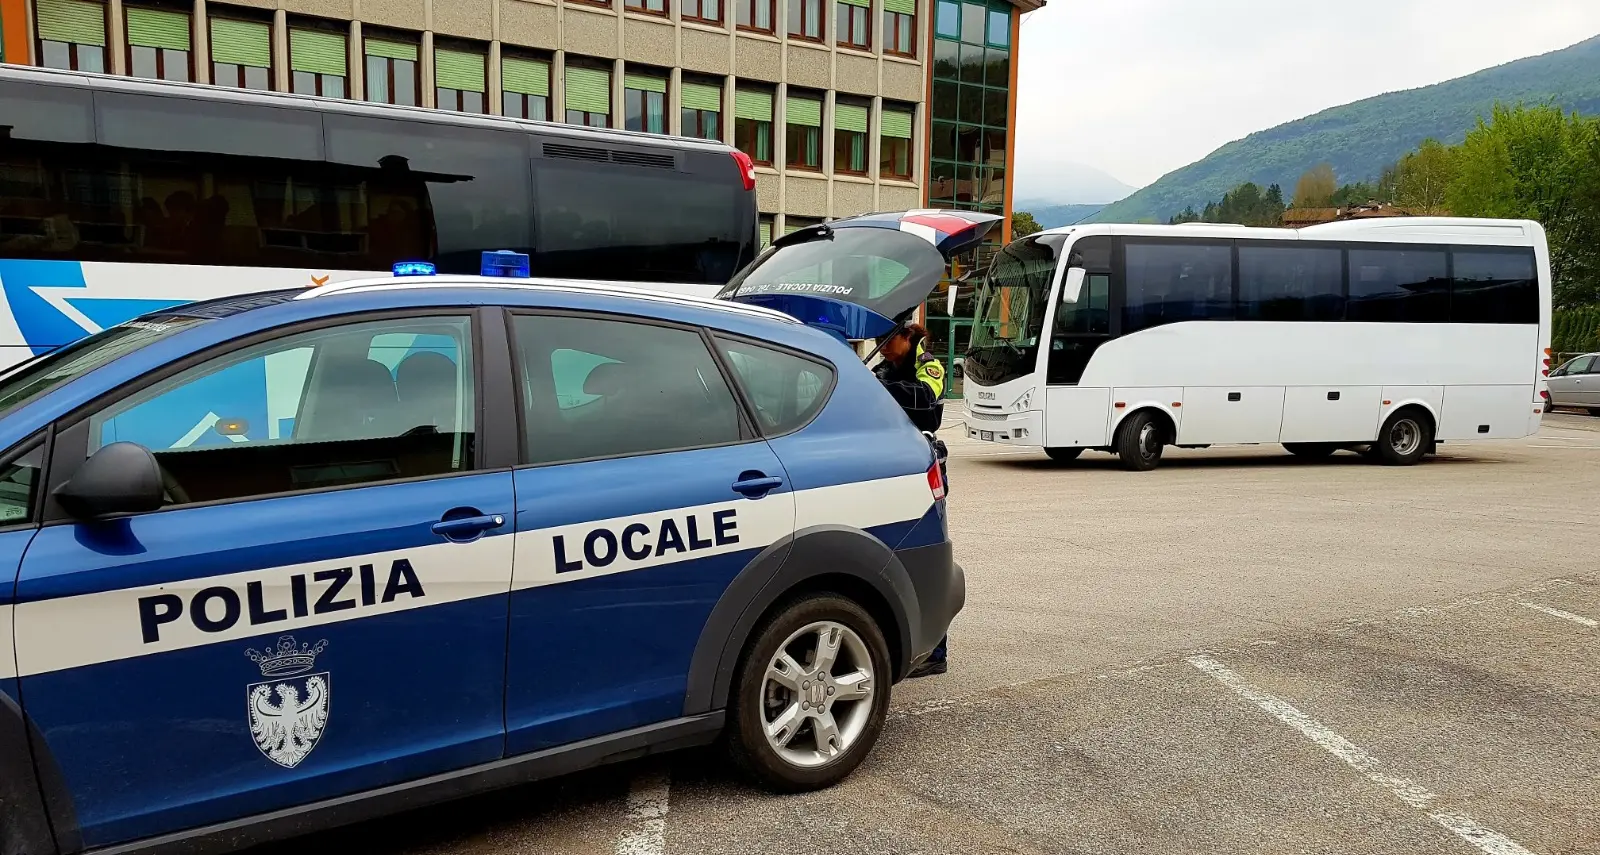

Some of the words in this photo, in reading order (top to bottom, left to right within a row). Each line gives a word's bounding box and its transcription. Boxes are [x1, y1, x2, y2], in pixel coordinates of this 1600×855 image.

[775, 283, 812, 291] LOCALE
[812, 284, 853, 294] POLIZIA
[139, 558, 425, 643] POLIZIA
[552, 509, 740, 574] LOCALE
